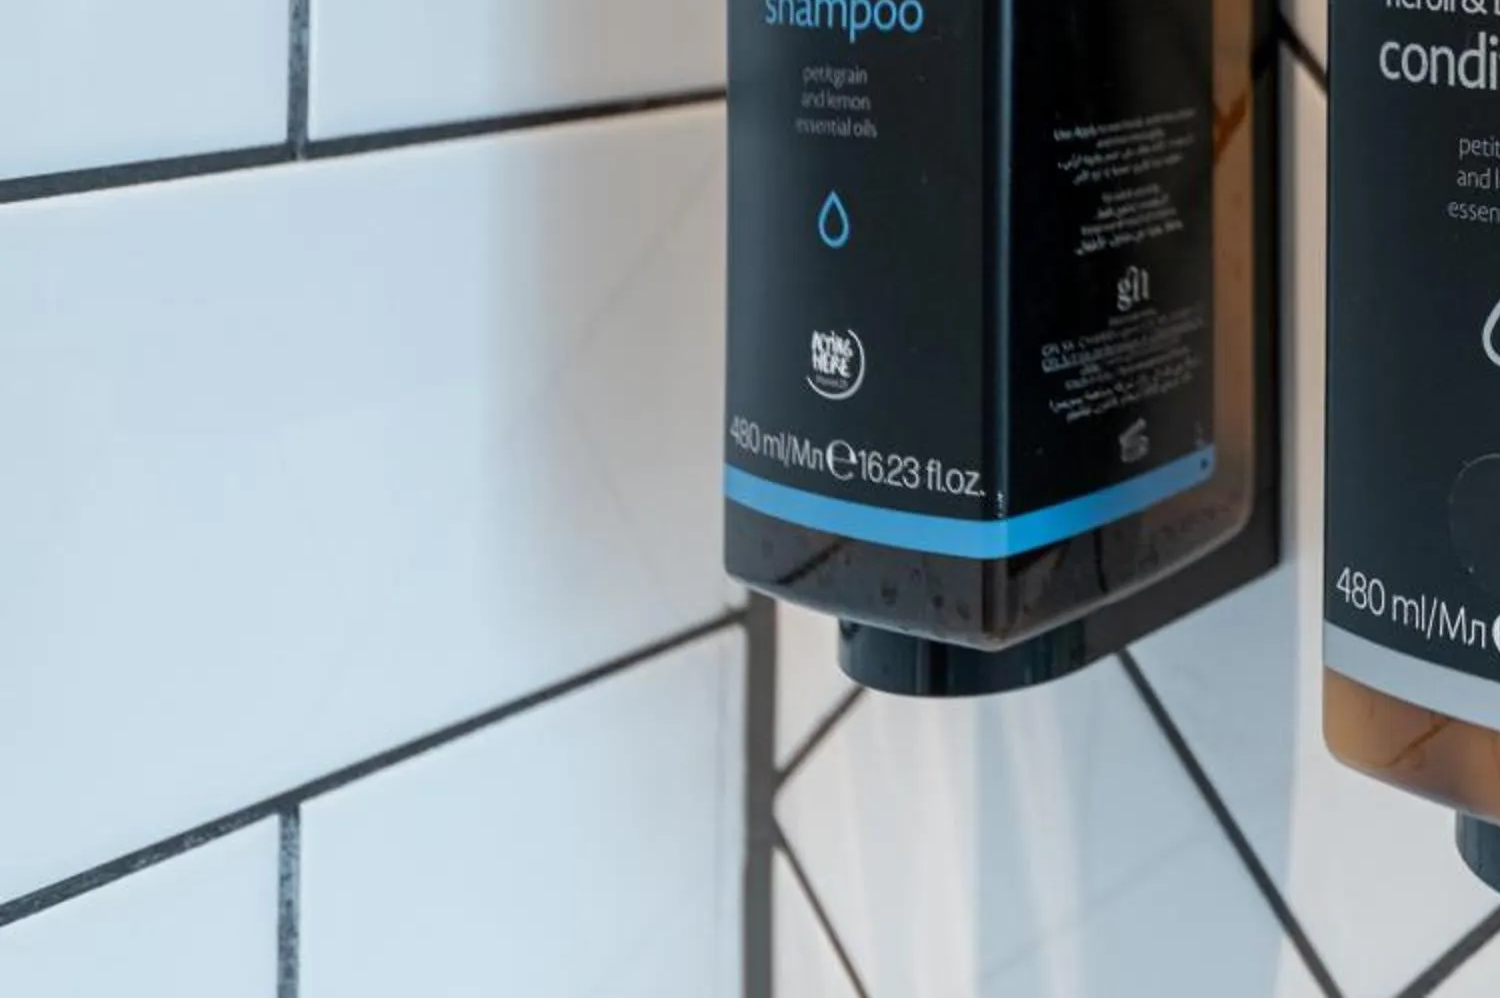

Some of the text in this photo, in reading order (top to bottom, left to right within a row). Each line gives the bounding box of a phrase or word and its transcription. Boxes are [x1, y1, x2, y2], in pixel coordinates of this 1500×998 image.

[800, 90, 871, 111] and lemon
[853, 120, 878, 138] oils
[1456, 168, 1491, 190] and
[730, 416, 760, 453] 480
[857, 450, 921, 489] 16.23
[1335, 567, 1386, 616] 480
